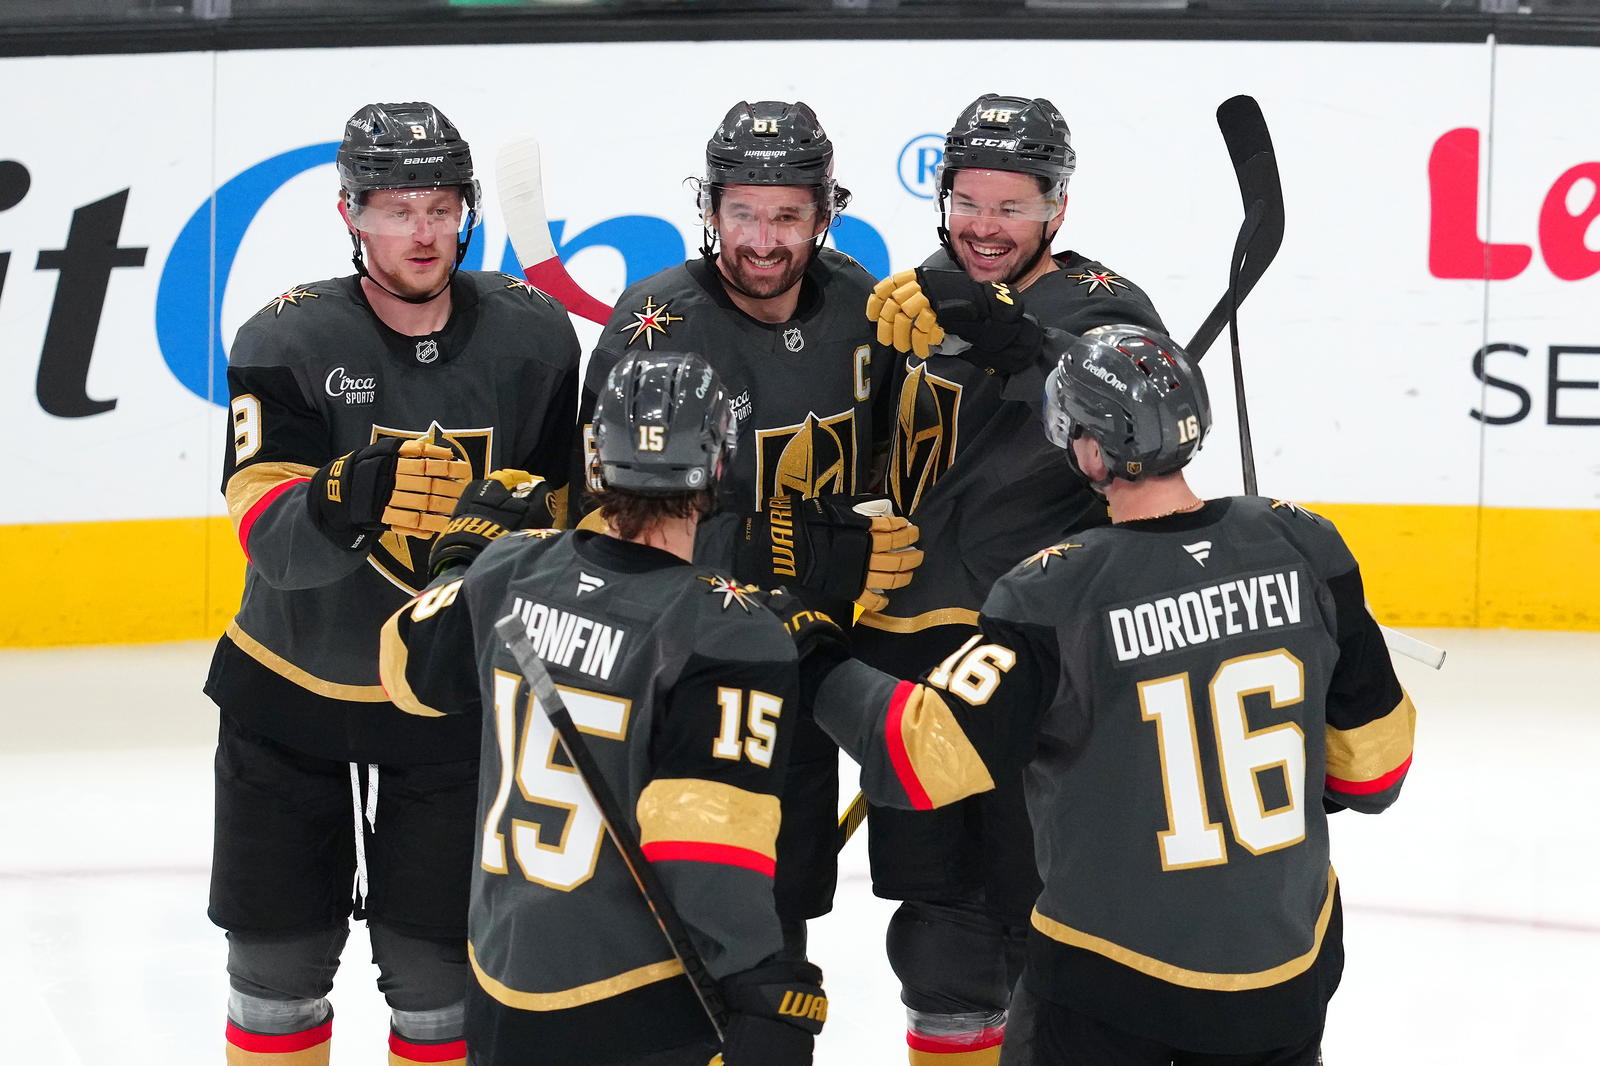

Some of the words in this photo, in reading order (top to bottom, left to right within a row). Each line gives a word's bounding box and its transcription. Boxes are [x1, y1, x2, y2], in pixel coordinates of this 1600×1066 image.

[410, 125, 427, 140] 9
[753, 119, 779, 133] 61
[970, 137, 1018, 150] CCM
[403, 156, 445, 165] BAUER
[325, 367, 376, 397] Circa
[853, 344, 871, 402] C
[1469, 342, 1600, 426] SE
[345, 391, 375, 405] SPORTS
[639, 425, 664, 451] 15
[1176, 414, 1198, 444] 16
[1109, 571, 1301, 661] DOROFEYEV
[926, 634, 1016, 706] 16
[712, 686, 784, 769] 15
[1136, 648, 1306, 872] 16
[481, 668, 632, 893] 15
